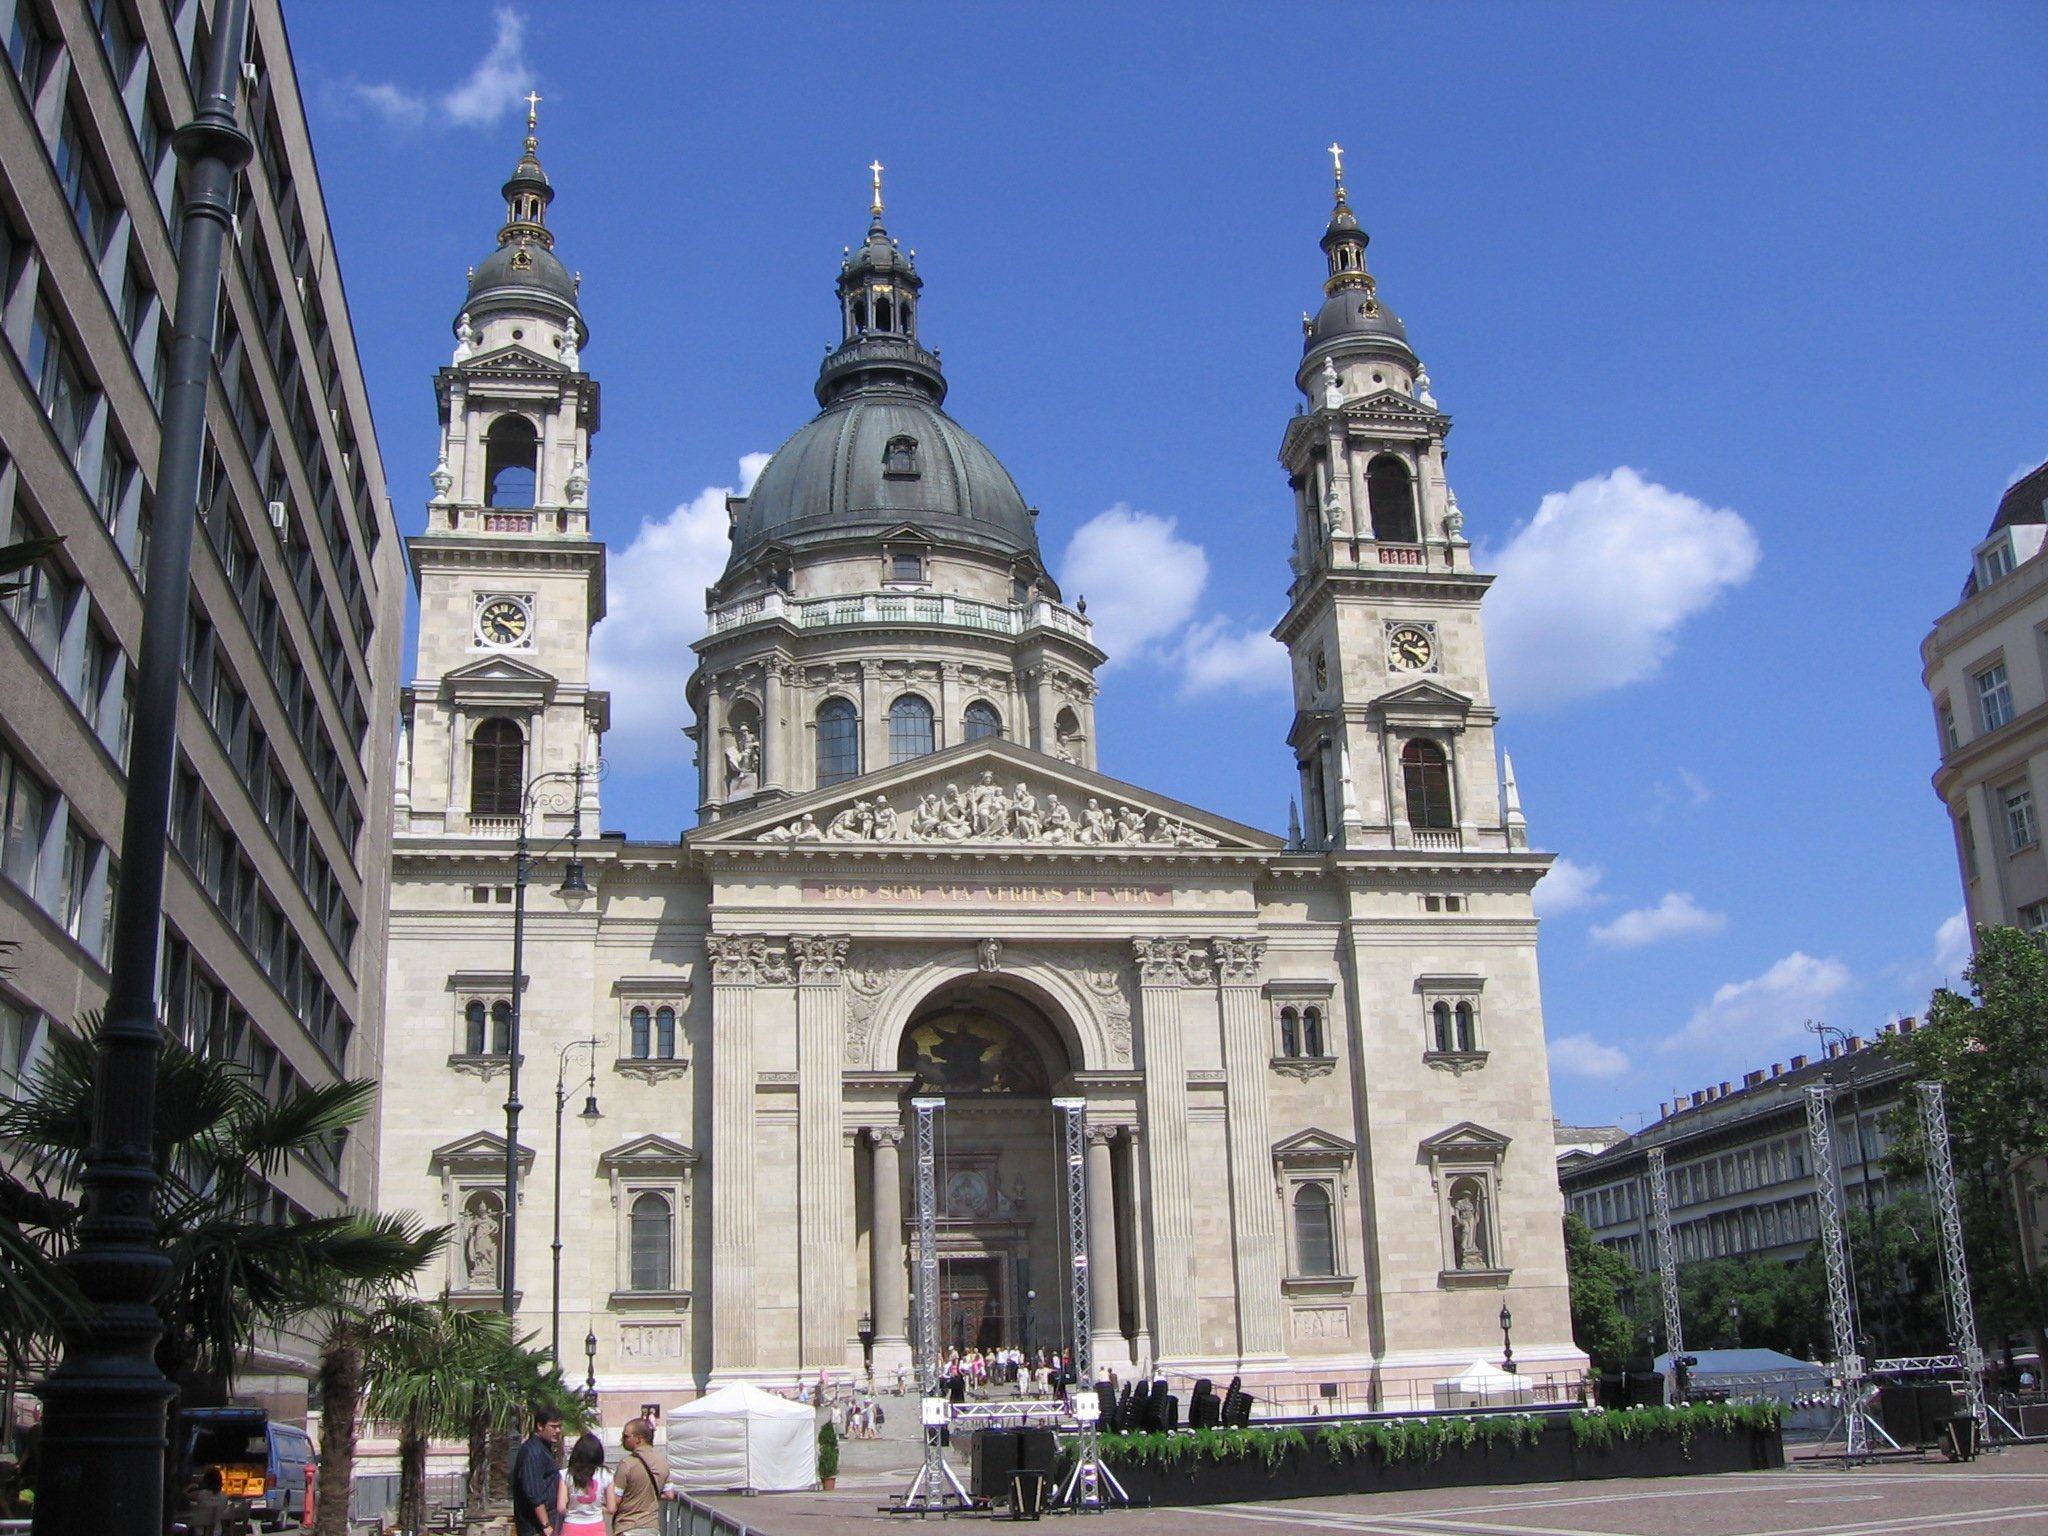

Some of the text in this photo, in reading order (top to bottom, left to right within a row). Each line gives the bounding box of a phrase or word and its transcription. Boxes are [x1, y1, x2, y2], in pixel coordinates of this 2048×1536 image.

[824, 884, 1152, 903] EGO SUM VIA VERITAS ET VITA
